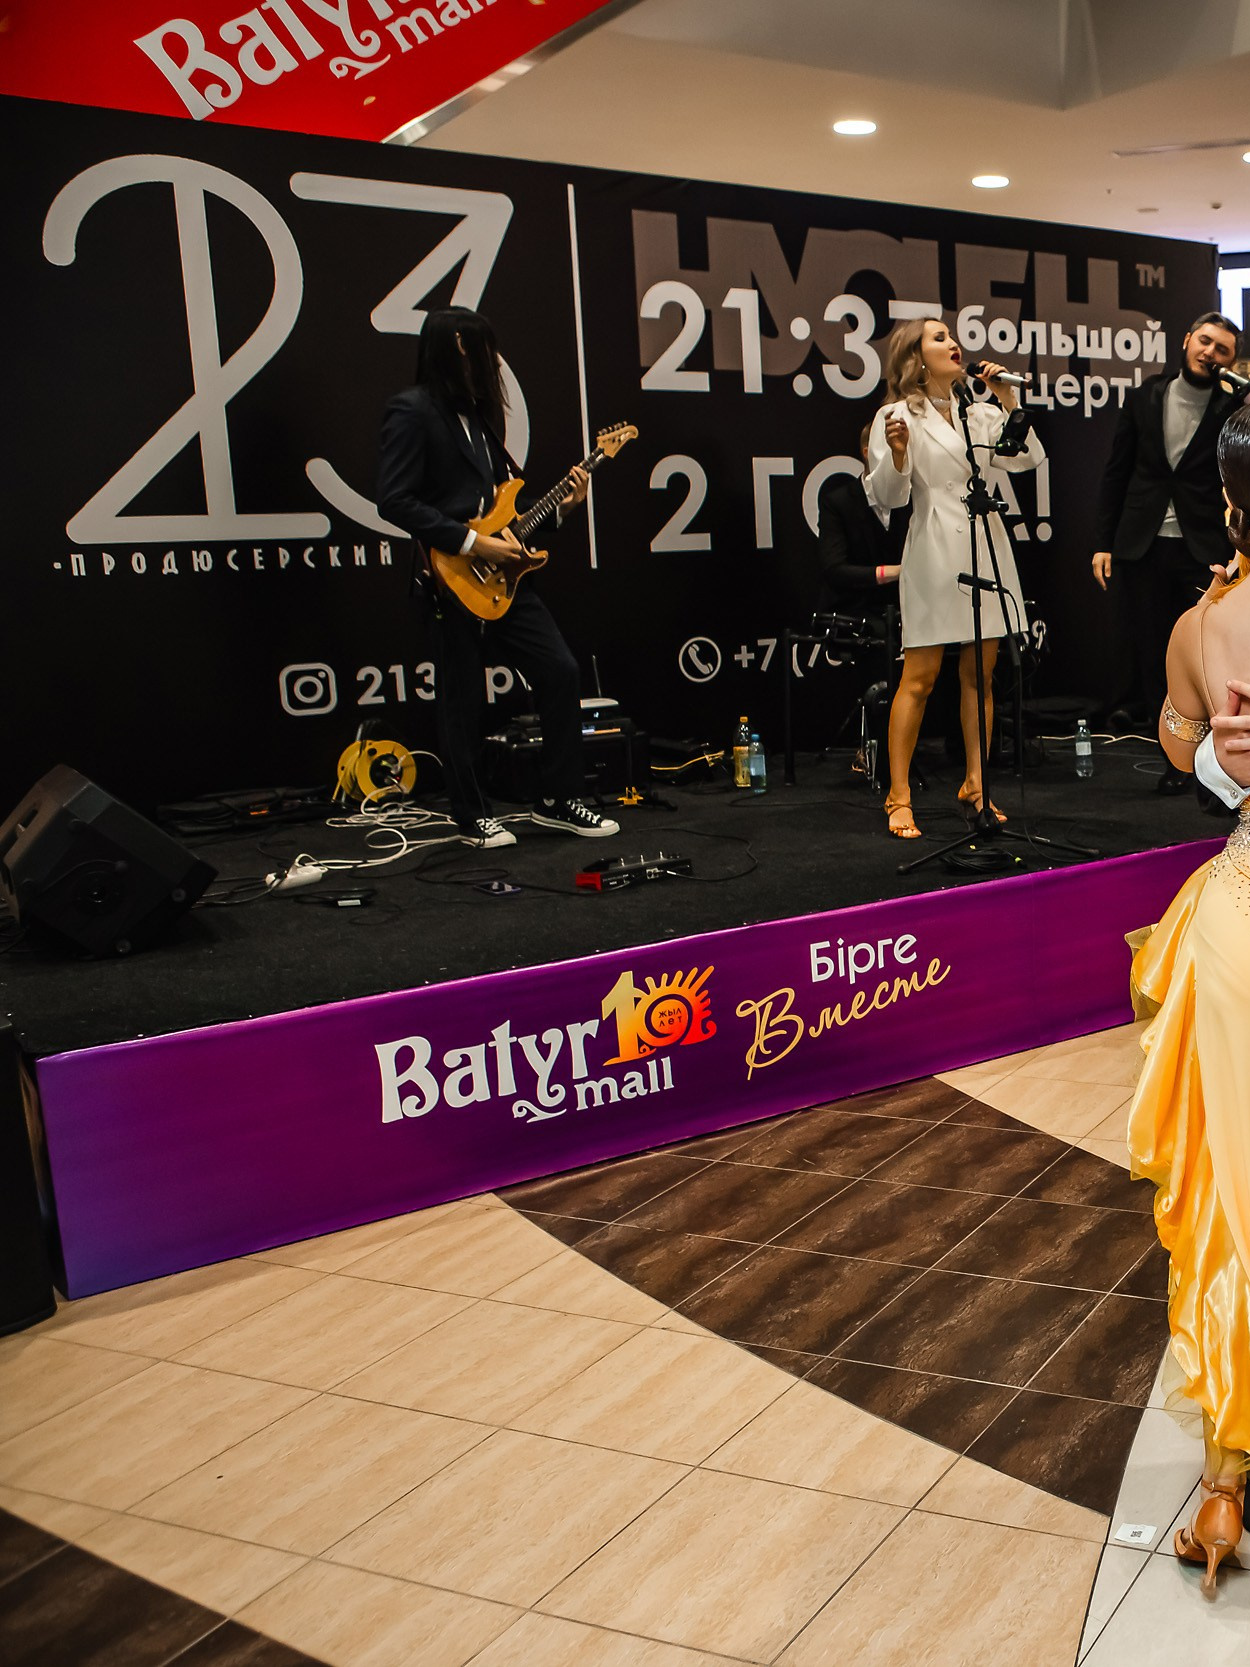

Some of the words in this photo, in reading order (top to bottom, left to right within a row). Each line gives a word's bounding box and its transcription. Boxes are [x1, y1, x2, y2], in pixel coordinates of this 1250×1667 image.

[385, 0, 498, 53] ma
[133, 0, 393, 120] Baty
[640, 281, 943, 398] 21:3
[957, 305, 1166, 363] большой
[649, 454, 711, 552] 2
[70, 540, 393, 577] ПРОДЮСЕРСКИЙ
[734, 638, 777, 672] +7
[810, 933, 919, 984] Бірге
[736, 959, 951, 1081] Вместе
[374, 1019, 600, 1124] Batyr
[575, 1057, 675, 1112] mall
